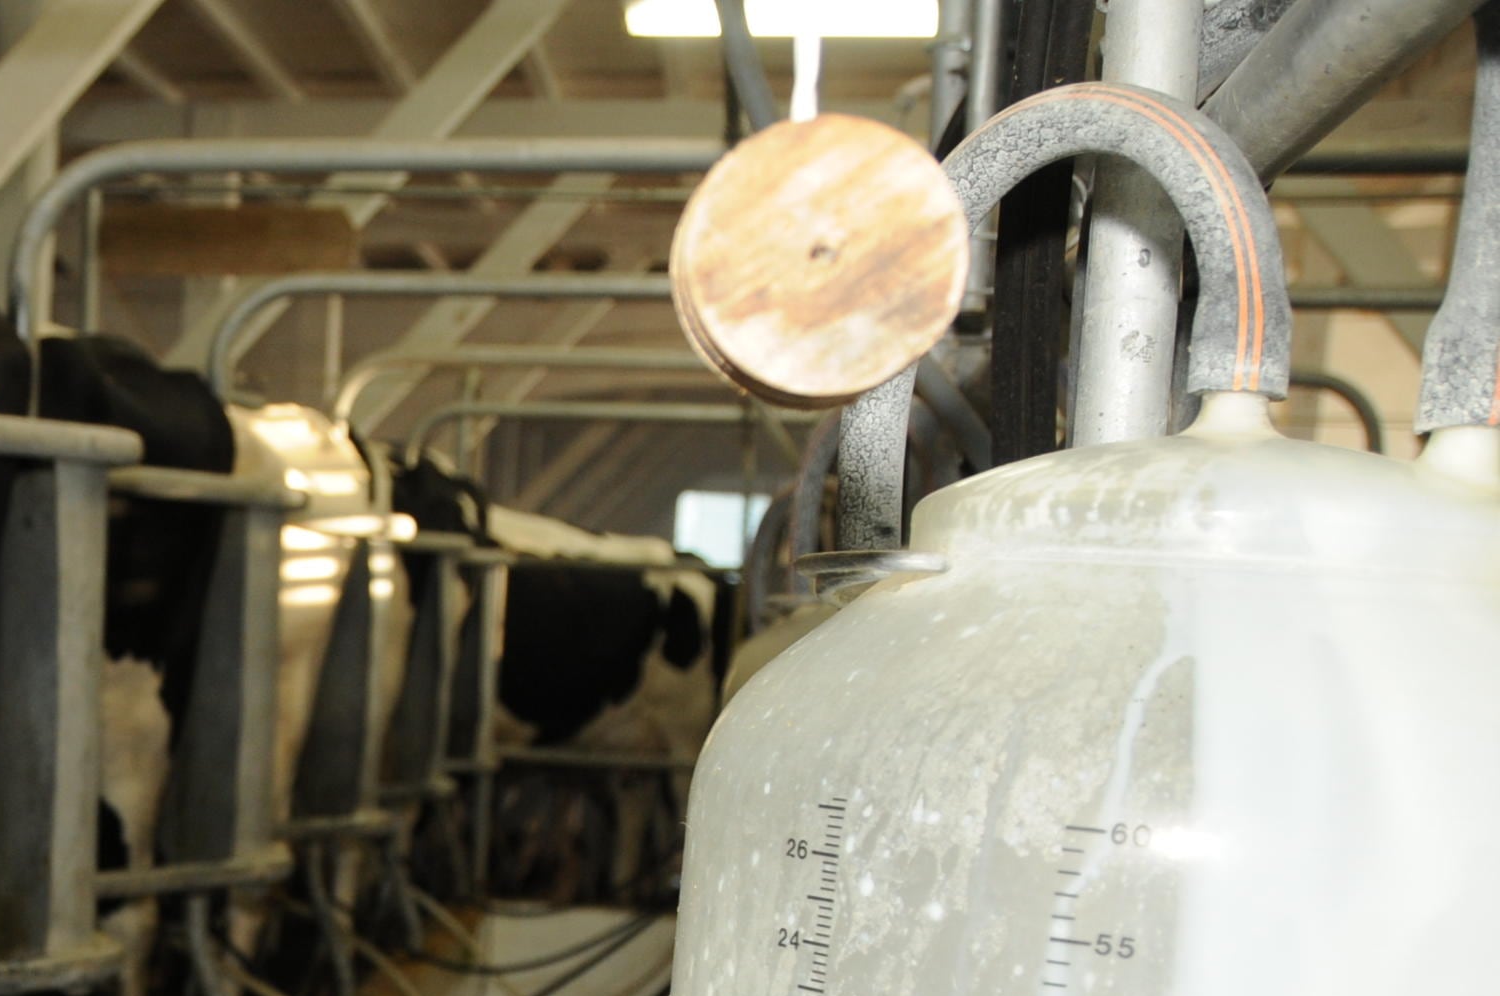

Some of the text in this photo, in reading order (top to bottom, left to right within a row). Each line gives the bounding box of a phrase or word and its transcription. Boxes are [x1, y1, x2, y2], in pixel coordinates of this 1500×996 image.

[1110, 822, 1152, 849] 60
[786, 838, 808, 860] 26
[777, 927, 801, 949] 24
[1094, 933, 1136, 960] 55
